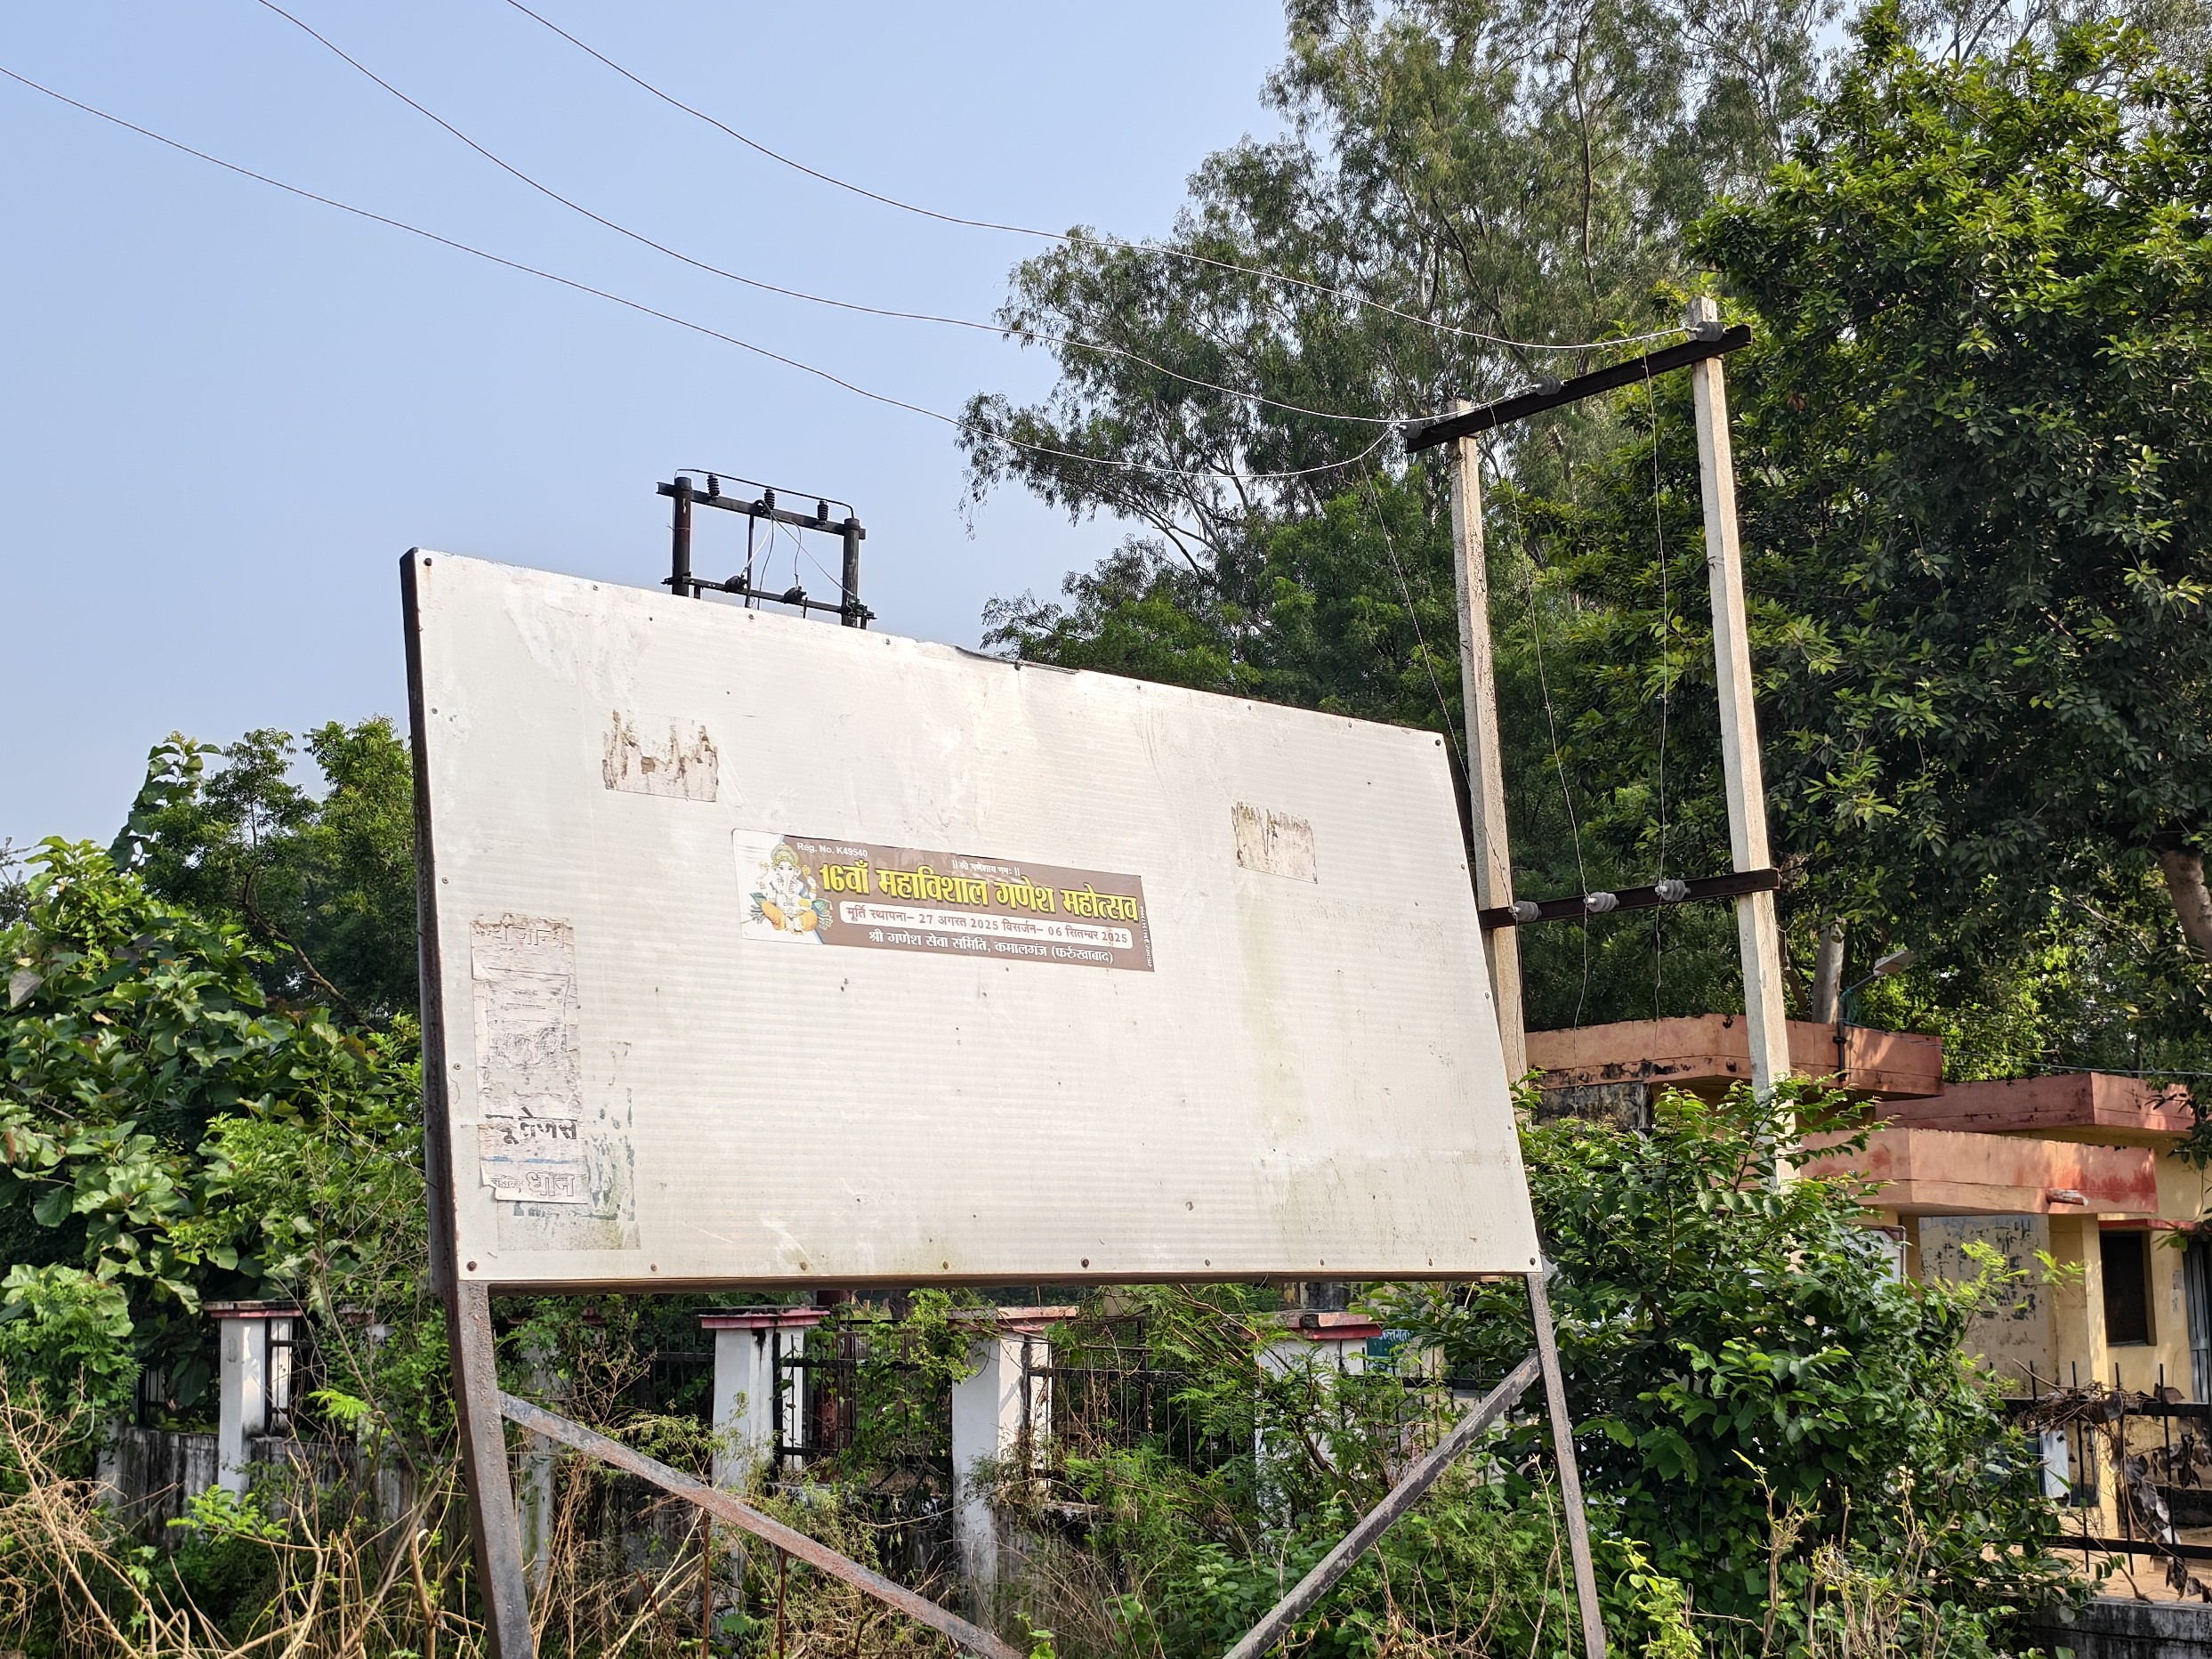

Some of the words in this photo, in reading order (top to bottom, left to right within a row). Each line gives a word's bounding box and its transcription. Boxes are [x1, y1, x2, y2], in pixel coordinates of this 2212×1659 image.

[797, 842, 817, 853] Reg.
[819, 845, 835, 854] No.
[836, 846, 868, 857] K49540
[959, 861, 969, 870] श्री
[970, 862, 997, 873] गणेशाय
[819, 859, 870, 894] 16वाँ
[876, 865, 989, 906] महाविशाल
[994, 875, 1056, 914] गणेश
[1059, 882, 1139, 922] महोत्सव
[845, 905, 866, 921] मूर्ति
[918, 913, 932, 925] 27
[938, 916, 966, 927] अगस्त
[970, 919, 998, 930] 2025
[1048, 927, 1062, 936] 06
[1065, 925, 1099, 940] सितम्बर
[1102, 932, 1127, 943] 2025
[868, 928, 884, 943] श्री
[886, 930, 922, 945] गणेश
[924, 933, 949, 948] सेवा
[951, 936, 991, 953] समिति,
[994, 942, 1047, 957] कमालगंज
